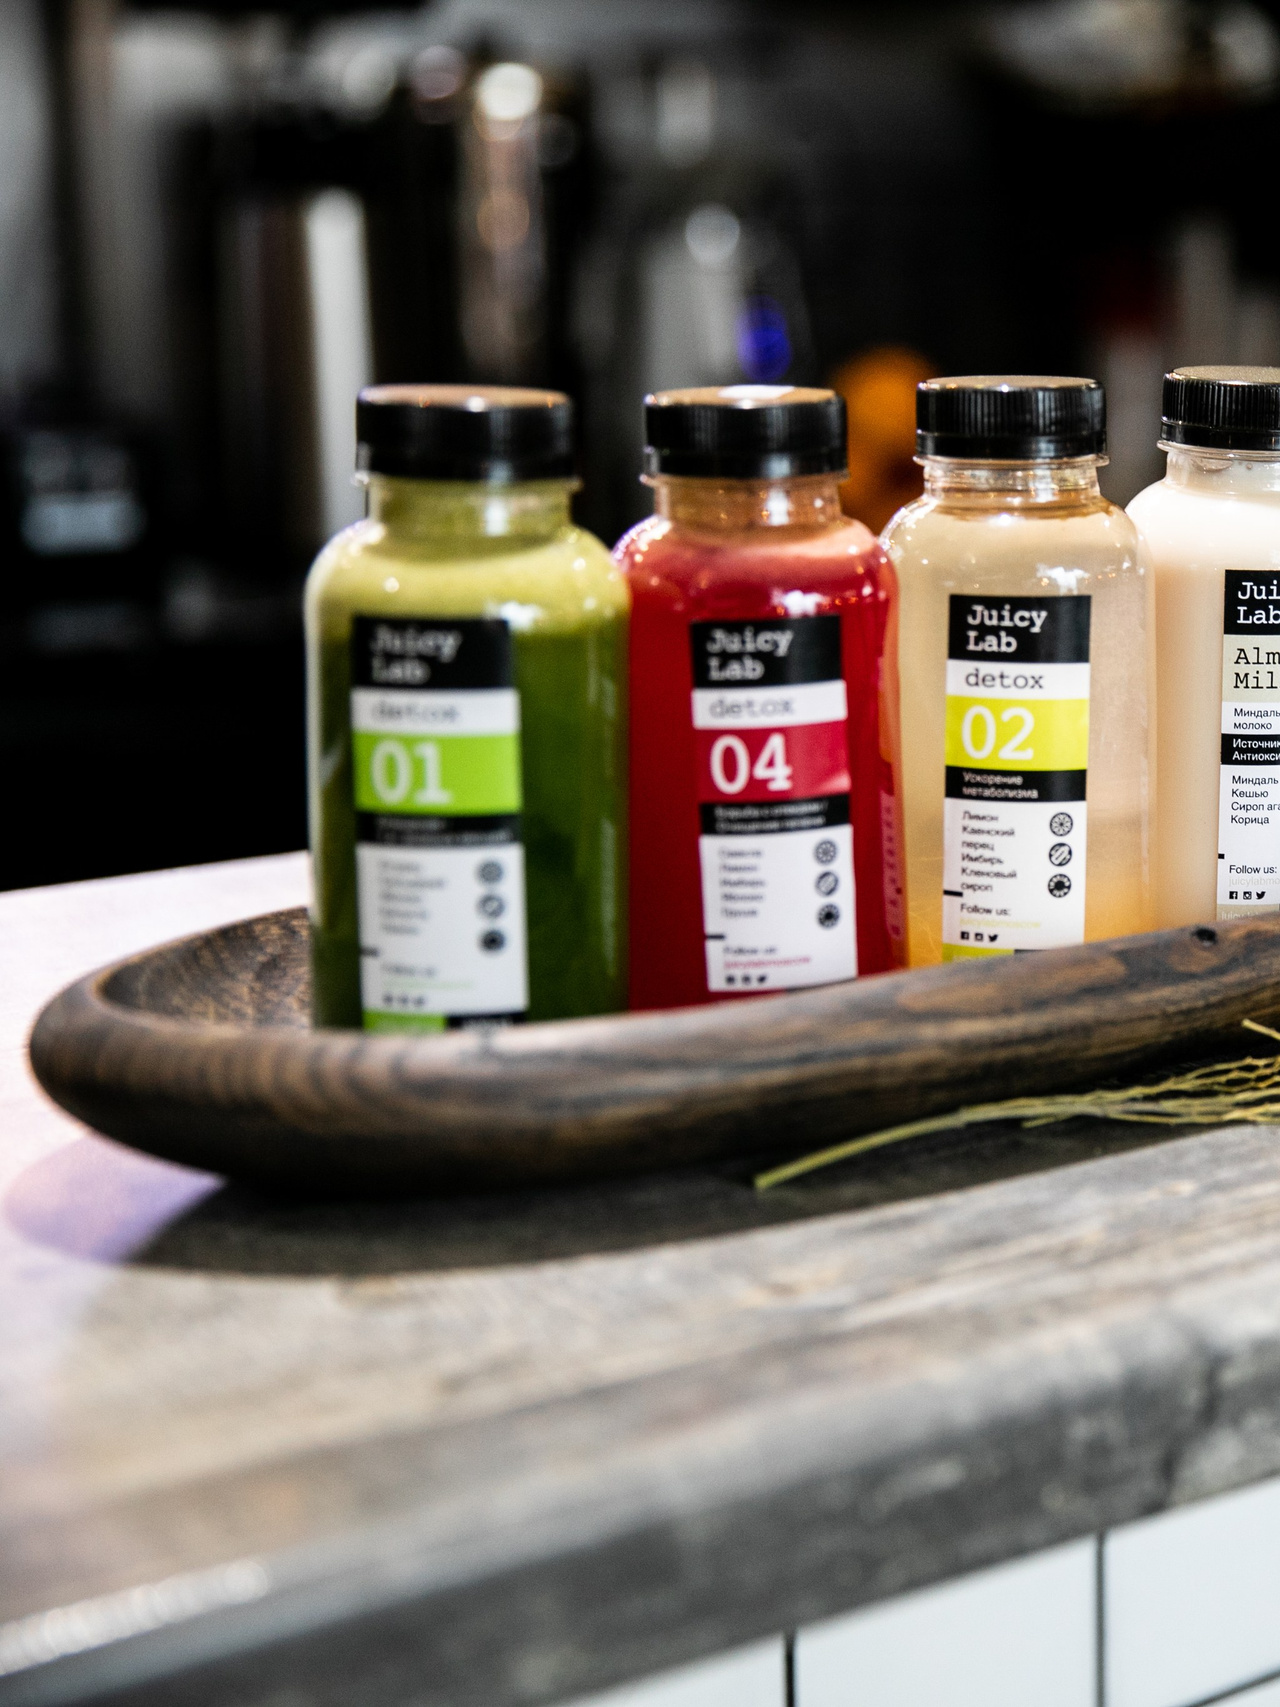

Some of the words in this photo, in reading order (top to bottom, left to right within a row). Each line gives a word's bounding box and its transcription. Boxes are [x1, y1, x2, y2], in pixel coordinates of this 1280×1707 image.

[967, 604, 1048, 633] Juicy
[706, 626, 794, 657] Juicy
[966, 631, 1018, 653] Lab
[708, 654, 765, 681] Lab
[965, 668, 1044, 689] detox
[709, 697, 794, 719] detox
[961, 705, 1035, 760] 02
[1233, 722, 1272, 730] молоко
[371, 740, 453, 805] 01
[710, 732, 793, 795] 04
[962, 771, 1024, 786] Ускорение
[1232, 775, 1279, 786] Миндаль
[1231, 789, 1268, 798] Кешью
[1231, 802, 1264, 813] Сироп
[1231, 815, 1269, 826] Корица
[1229, 865, 1260, 874] Follow
[1263, 865, 1277, 874] us:
[960, 903, 992, 915] Follow
